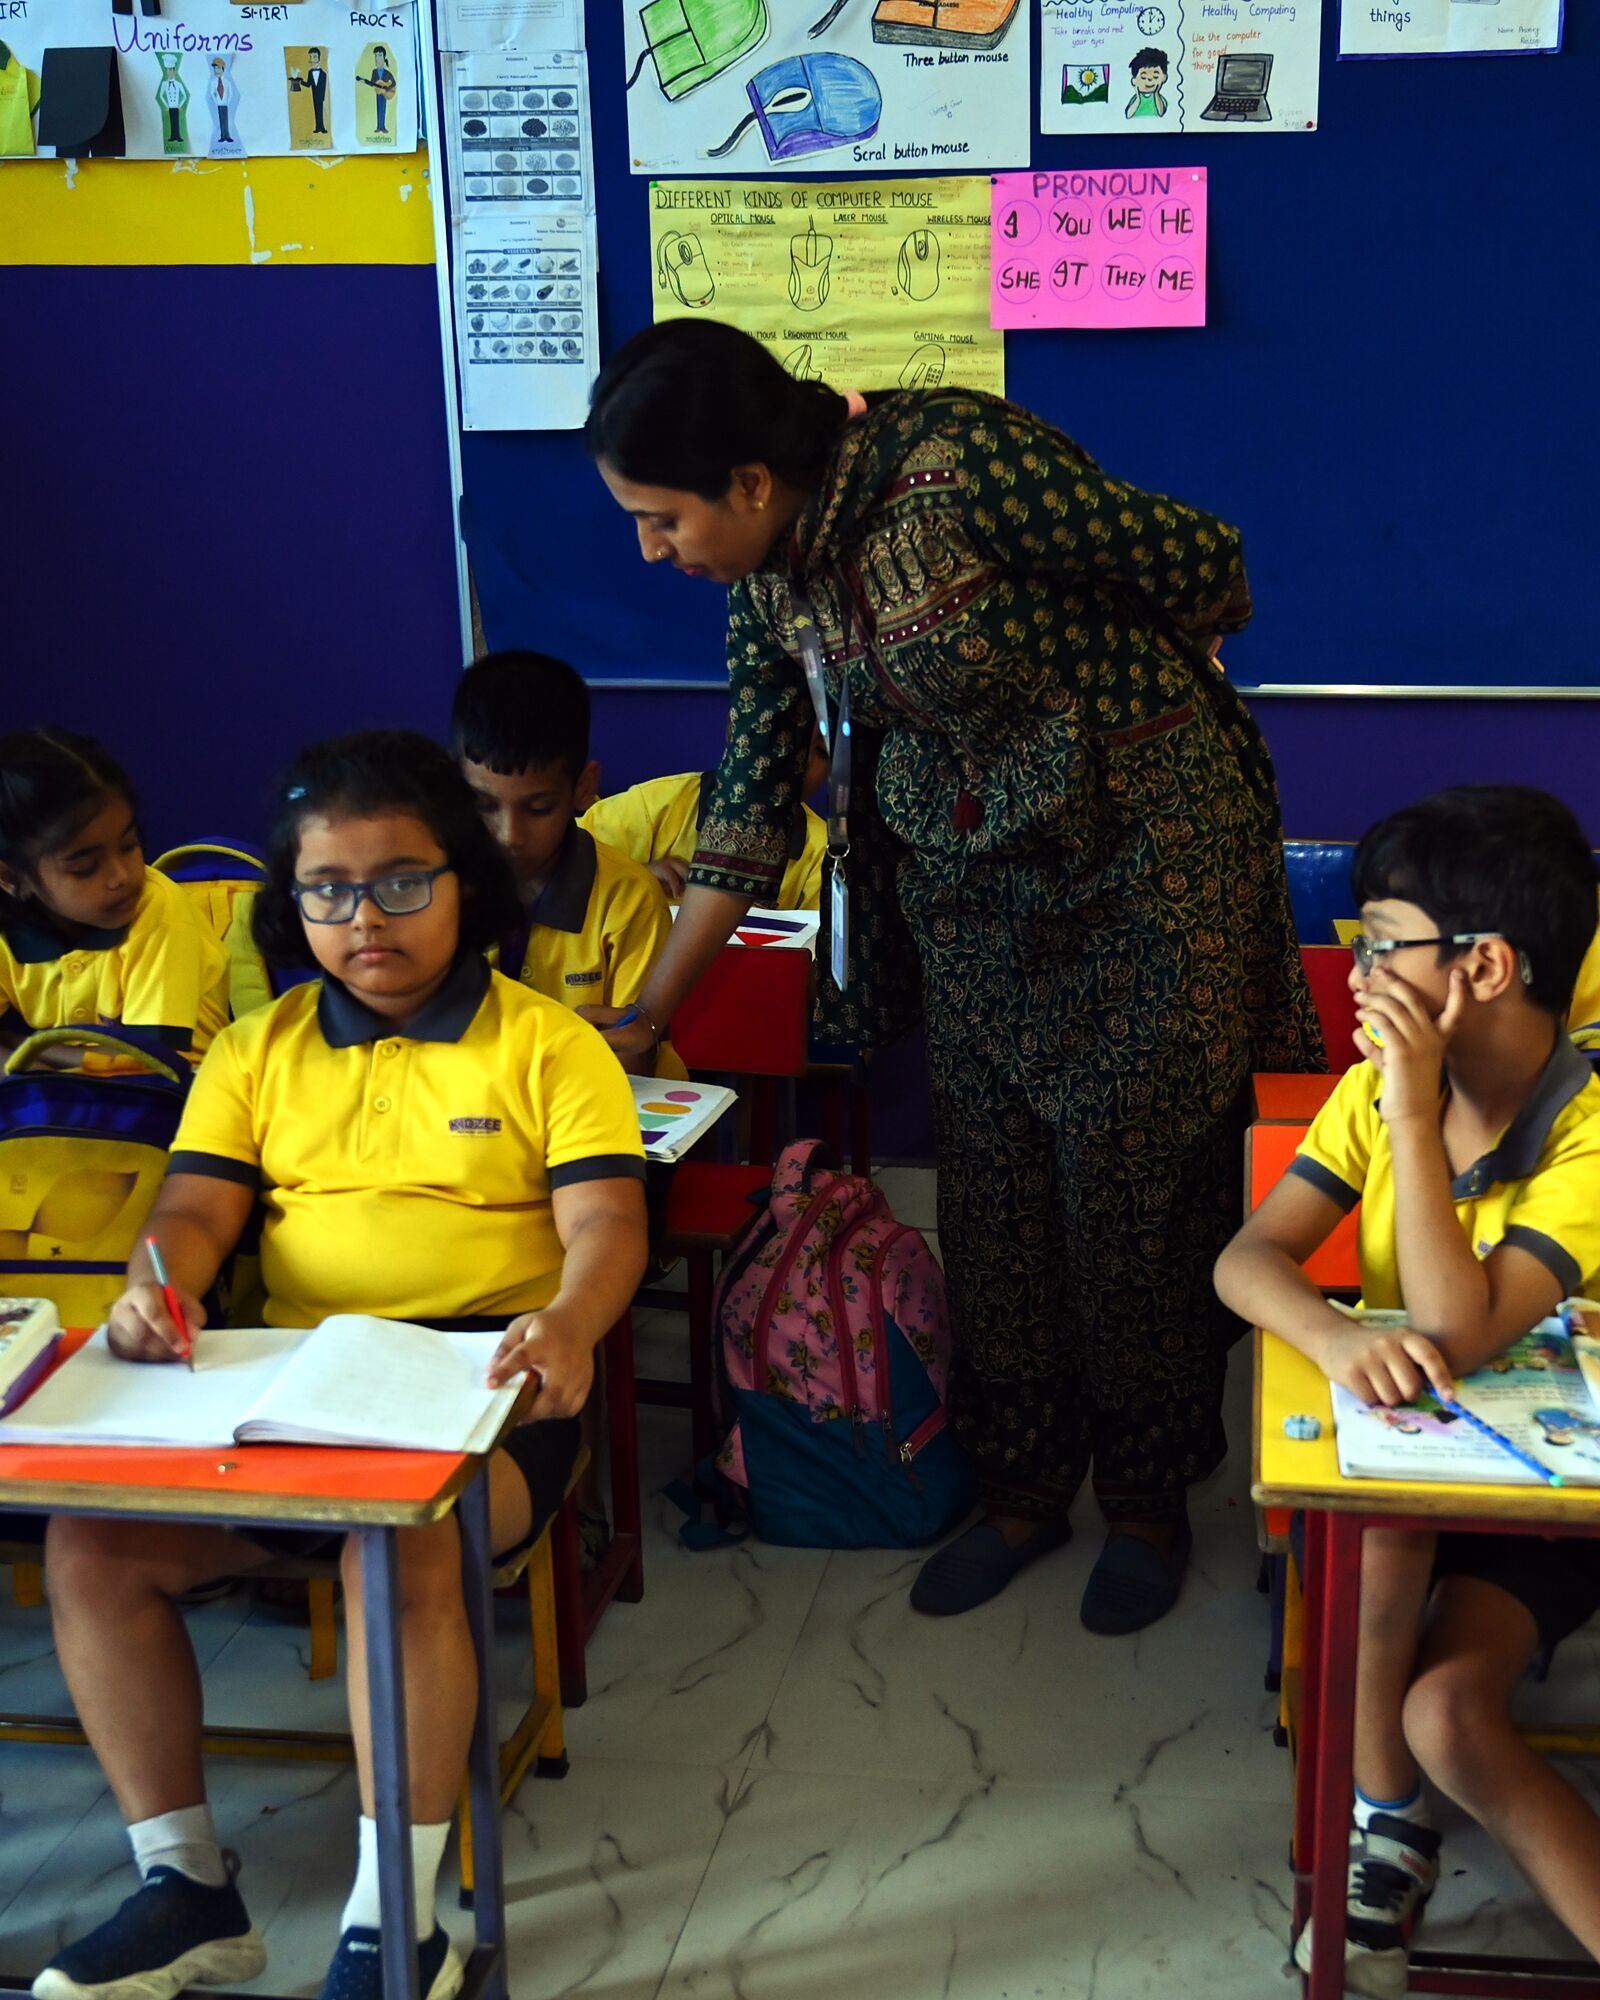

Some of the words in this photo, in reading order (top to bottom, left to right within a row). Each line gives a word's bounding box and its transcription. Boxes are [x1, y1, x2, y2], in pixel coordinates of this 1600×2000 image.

[0, 1, 27, 19] IRT
[241, 5, 289, 21] SHIRT
[1056, 7, 1093, 22] Healthy
[1101, 3, 1145, 19] Computing
[1202, 4, 1238, 21] Healthy
[1249, 3, 1296, 22] Computing
[350, 12, 404, 28] FROCK
[1369, 8, 1411, 32] things
[112, 16, 254, 53] Uniforms
[1051, 26, 1068, 36] Take
[1072, 26, 1095, 35] breaks
[1097, 25, 1111, 34] and
[1112, 25, 1124, 33] rest
[1208, 32, 1221, 41] the
[1226, 29, 1262, 44] computer
[1072, 39, 1087, 49] your
[1091, 38, 1105, 49] eyes
[903, 53, 935, 67] Three
[939, 51, 969, 65] button
[974, 52, 1009, 63] mouse
[1192, 47, 1203, 58] for
[1207, 45, 1228, 60] good
[1191, 61, 1215, 73] things
[894, 143, 928, 160] button
[931, 142, 970, 156] mouse
[1033, 173, 1171, 198] PRONOUN
[656, 189, 731, 209] DIFFERENT
[744, 191, 783, 208] KINDS
[791, 190, 808, 208] OF
[816, 191, 882, 208] COMPUTER
[892, 192, 933, 207] MOUSE
[711, 213, 744, 223] OPTICAL
[750, 214, 776, 223] MOUSE
[862, 213, 886, 222] MOUSE
[927, 215, 964, 223] WIRELESS
[967, 215, 992, 224] MOUSE
[1053, 211, 1091, 236] YOU
[1108, 208, 1142, 230] WE
[1160, 208, 1193, 234] HE
[1000, 267, 1040, 289] SHE
[1106, 265, 1146, 287] THEY
[1158, 269, 1194, 290] ME
[756, 331, 777, 339] MOUSE
[783, 329, 822, 339] ERGONOMIC
[826, 331, 848, 339] MOUSE
[913, 331, 945, 341] GAMING
[950, 333, 974, 343] MOUSE
[449, 1117, 502, 1132] KIDZEE
